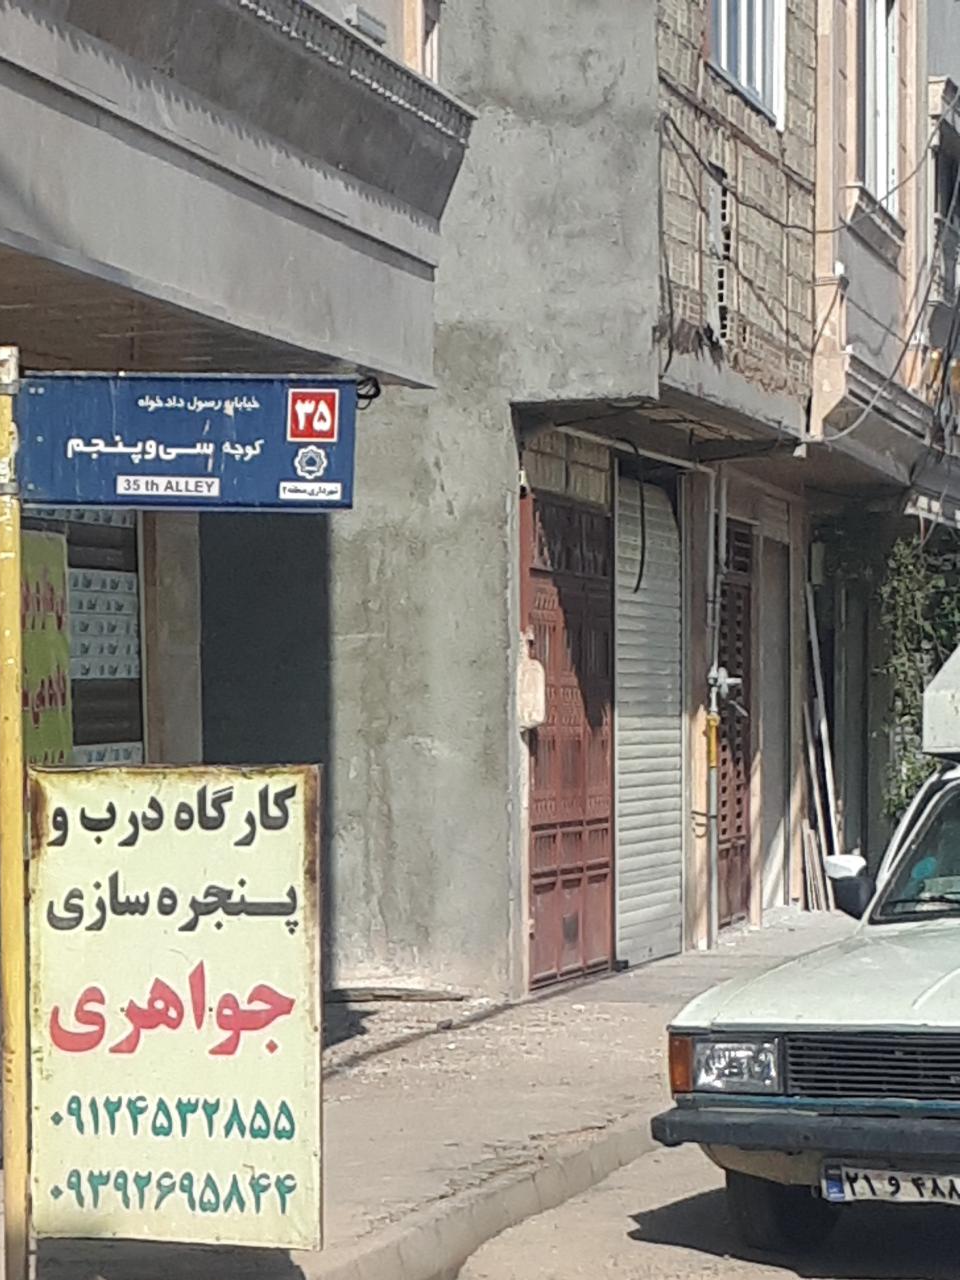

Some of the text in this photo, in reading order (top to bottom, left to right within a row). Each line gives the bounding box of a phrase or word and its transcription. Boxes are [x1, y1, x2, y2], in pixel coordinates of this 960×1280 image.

[187, 395, 222, 412] رسول
[295, 399, 332, 432] ۳۵
[221, 439, 265, 461] کوچه
[123, 479, 141, 491] 35
[163, 480, 215, 493] ALLEY
[46, 806, 69, 847] و
[79, 796, 164, 846] درب
[46, 870, 150, 931] سازی
[49, 959, 297, 1056] جواهری
[50, 1095, 296, 1140] ۰۹۱۲۴۵۳۲۸۵۵
[50, 1168, 298, 1215] ۰۹۳۹۲۶۹۵۸۴۴
